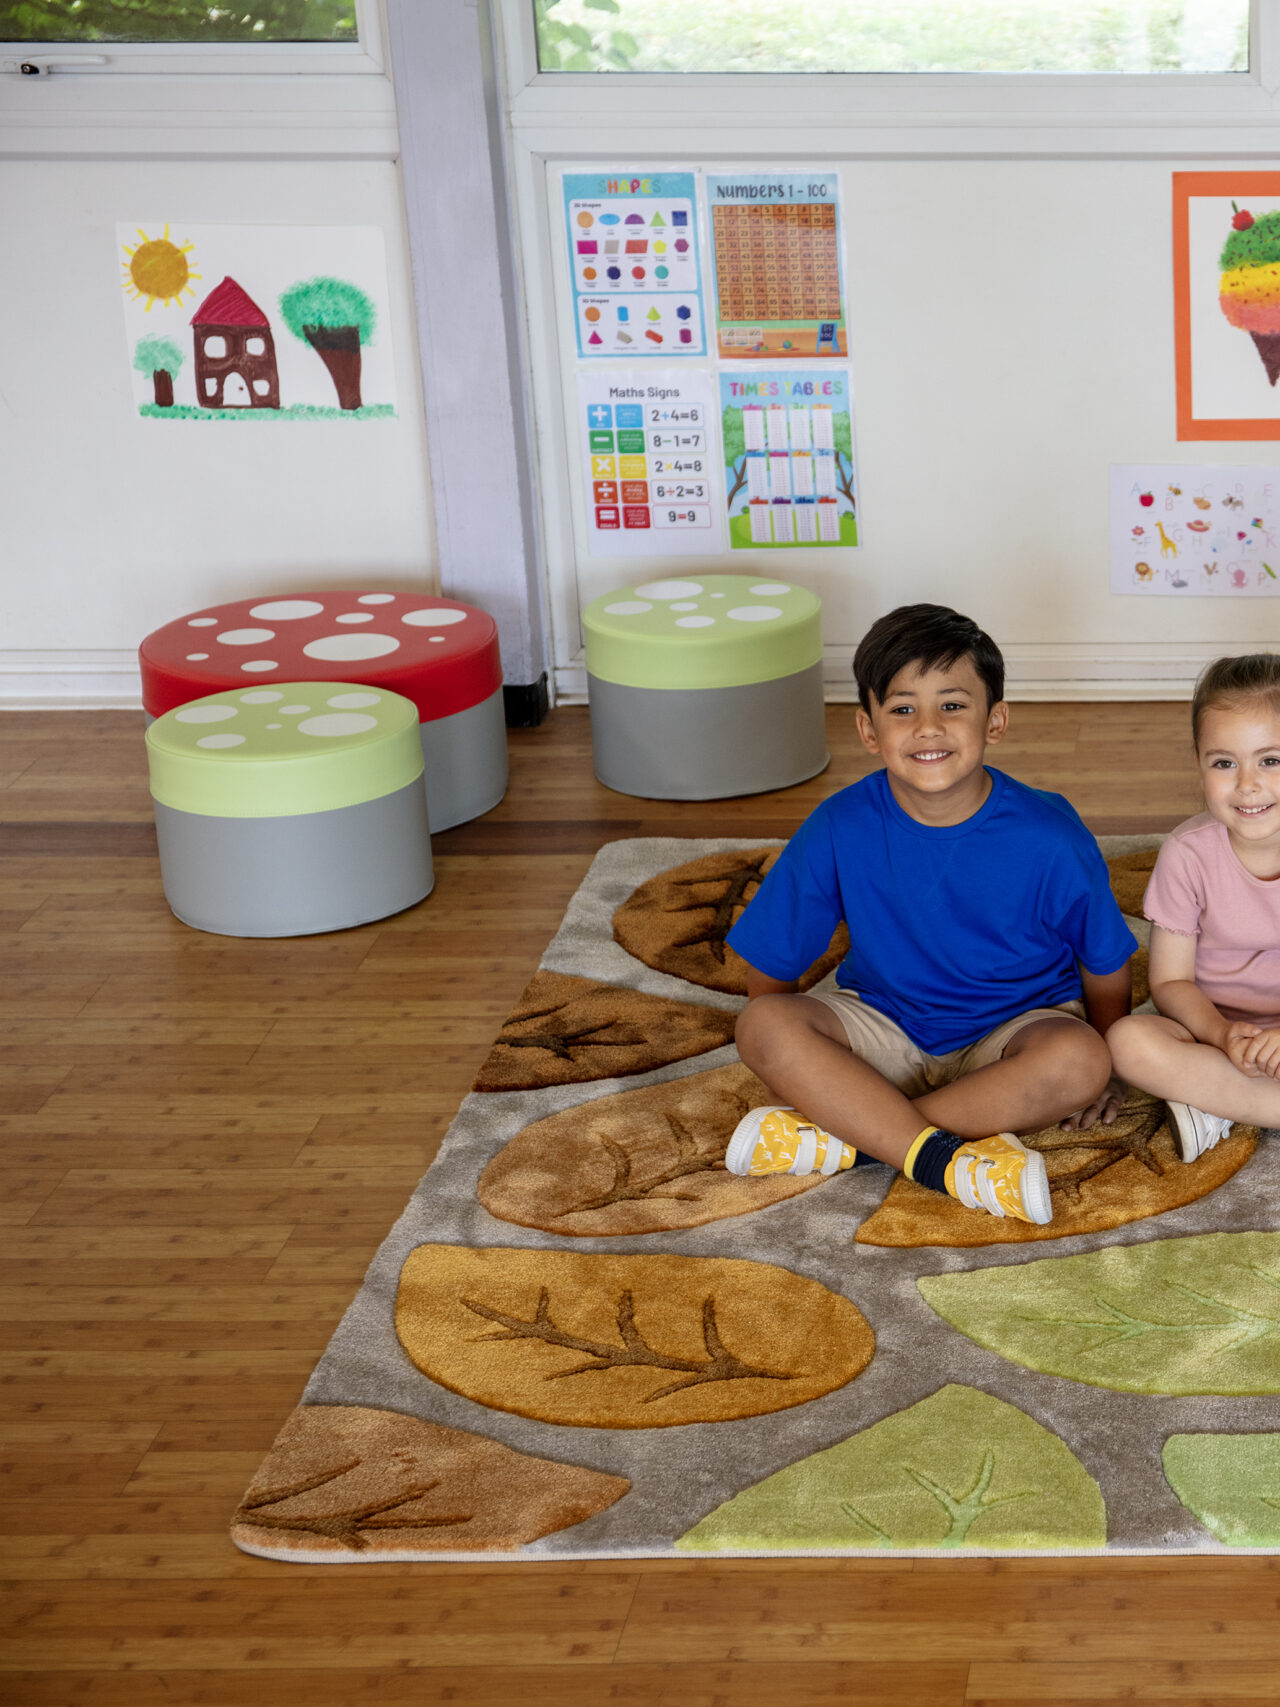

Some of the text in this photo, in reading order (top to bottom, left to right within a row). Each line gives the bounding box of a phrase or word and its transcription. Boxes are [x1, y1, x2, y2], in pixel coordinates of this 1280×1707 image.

[597, 178, 661, 194] SHAPES
[716, 183, 784, 199] Numbers
[788, 184, 794, 198] 1
[808, 183, 828, 197] 100
[609, 386, 680, 400] Maths Signs
[730, 380, 843, 396] TIMES TABLES
[651, 410, 699, 422] 2+4=6
[668, 511, 696, 522] 9=9
[1165, 569, 1180, 580] M
